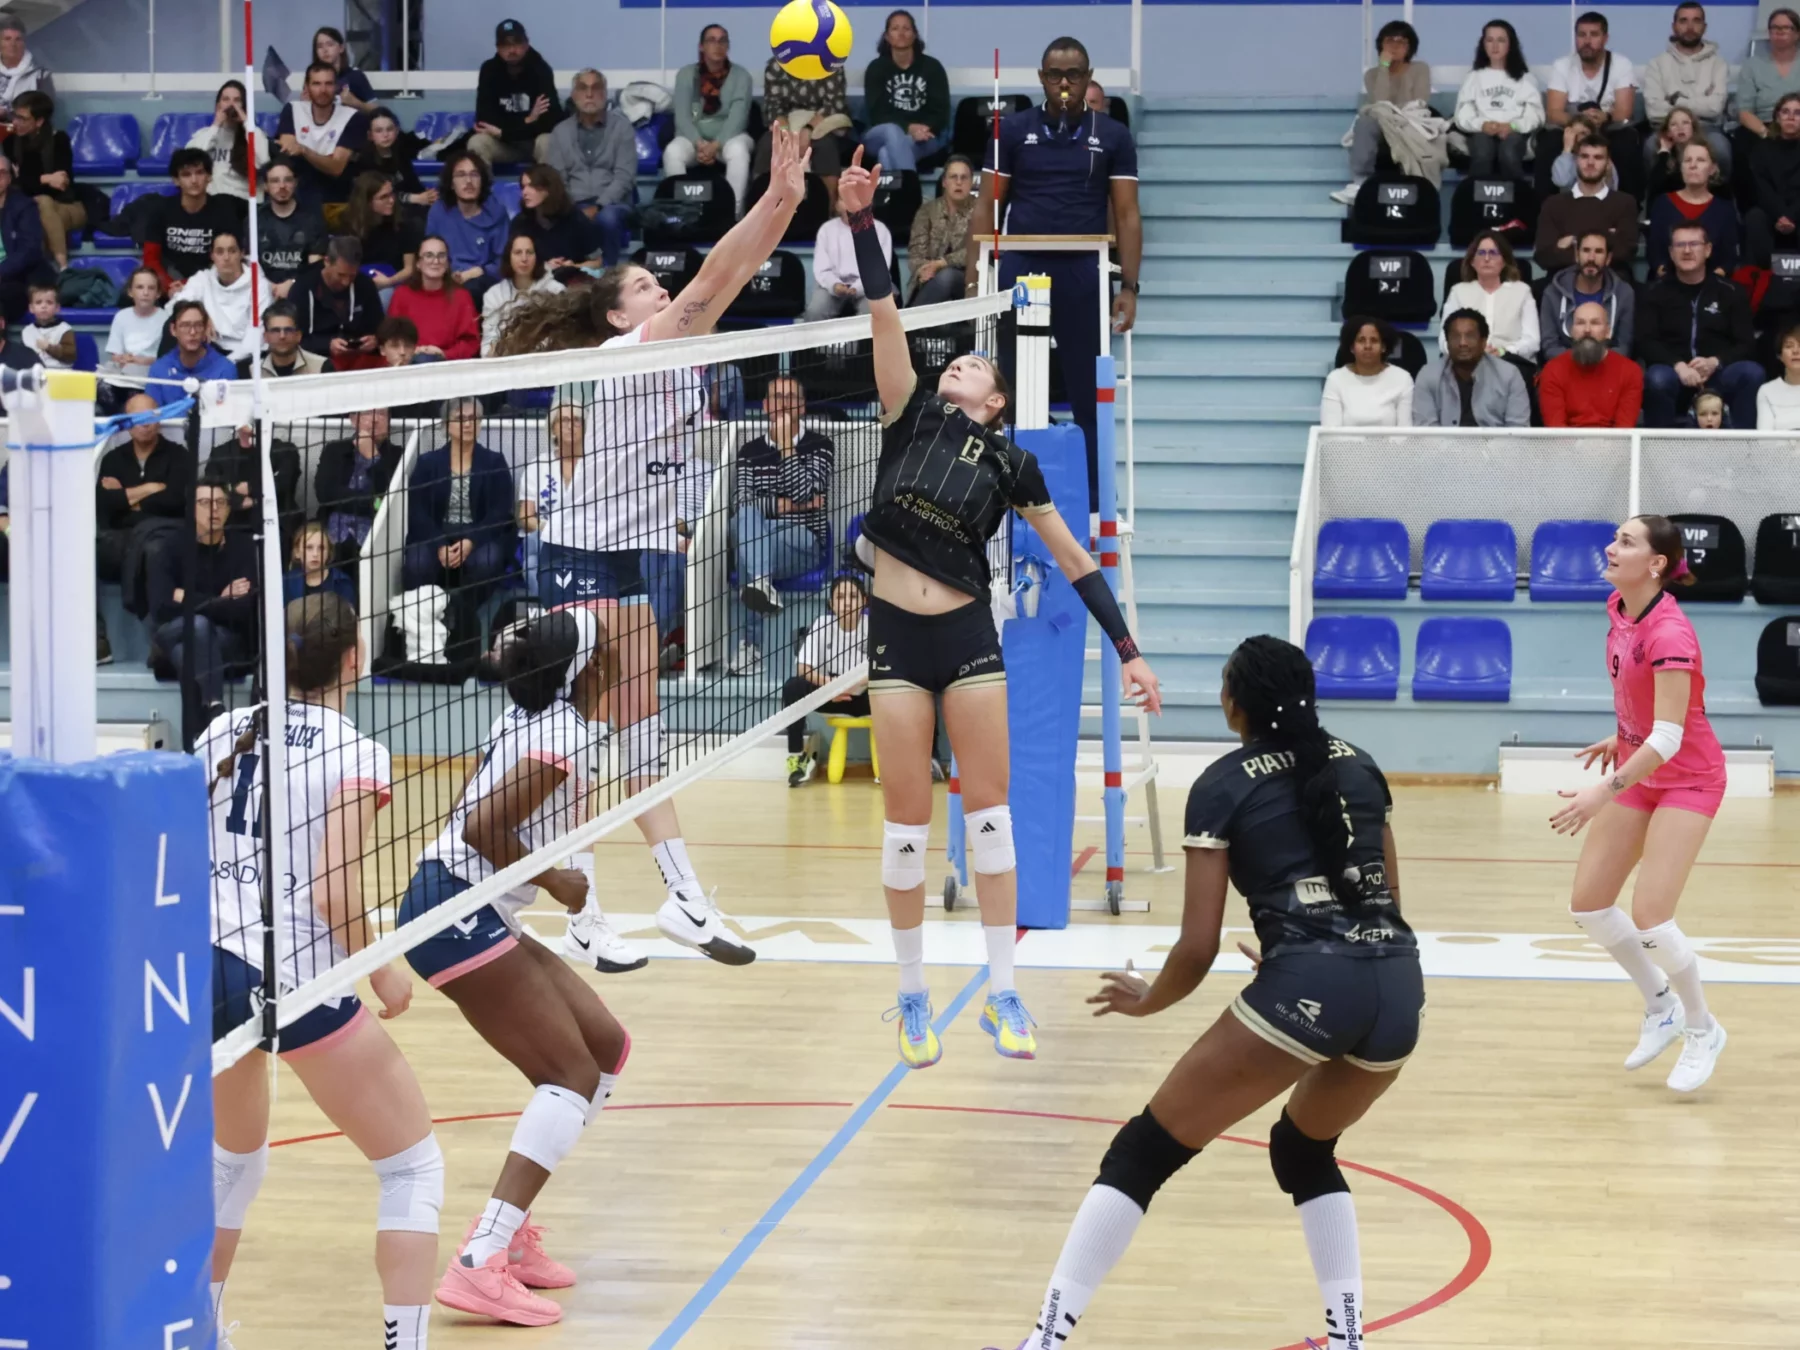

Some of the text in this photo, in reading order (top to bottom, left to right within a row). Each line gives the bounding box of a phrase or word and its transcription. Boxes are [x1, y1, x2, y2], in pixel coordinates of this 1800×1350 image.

[987, 101, 1007, 111] VP
[683, 185, 704, 196] VIP
[1387, 188, 1409, 199] VIP
[1484, 185, 1505, 196] VIP
[262, 251, 303, 264] QATAR
[655, 255, 676, 266] VIP
[1379, 261, 1401, 273] VIP
[960, 434, 986, 464] 13
[1684, 528, 1709, 541] VIP
[1611, 654, 1620, 678] 9
[1341, 1292, 1358, 1350] inesquared
